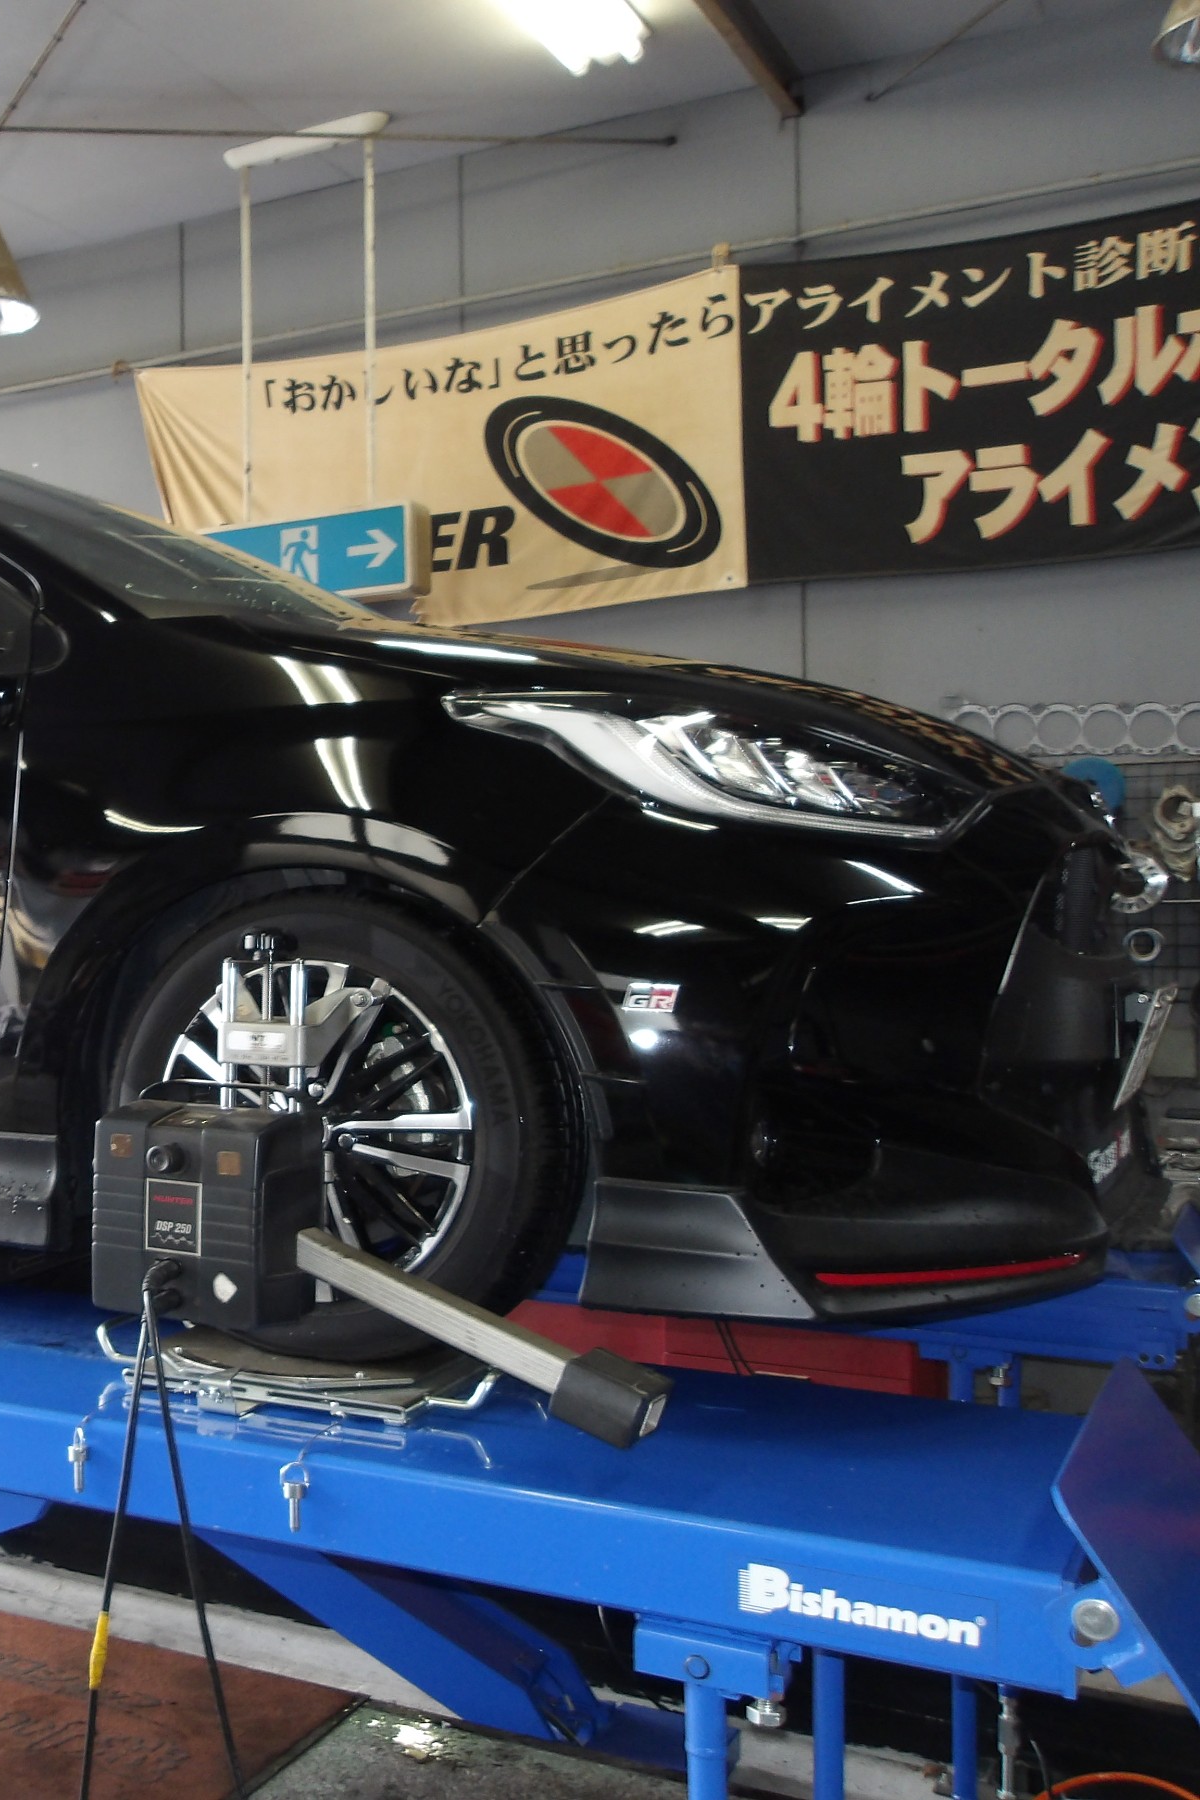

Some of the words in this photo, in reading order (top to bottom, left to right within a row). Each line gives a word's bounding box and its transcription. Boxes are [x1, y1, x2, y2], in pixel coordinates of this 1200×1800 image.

[901, 418, 1200, 544] アライメ
[625, 989, 677, 1010] GR
[438, 979, 513, 1126] YOKOHAMA
[155, 1220, 174, 1232] DSP
[174, 1222, 192, 1234] 250
[738, 1563, 981, 1647] Bishamon
